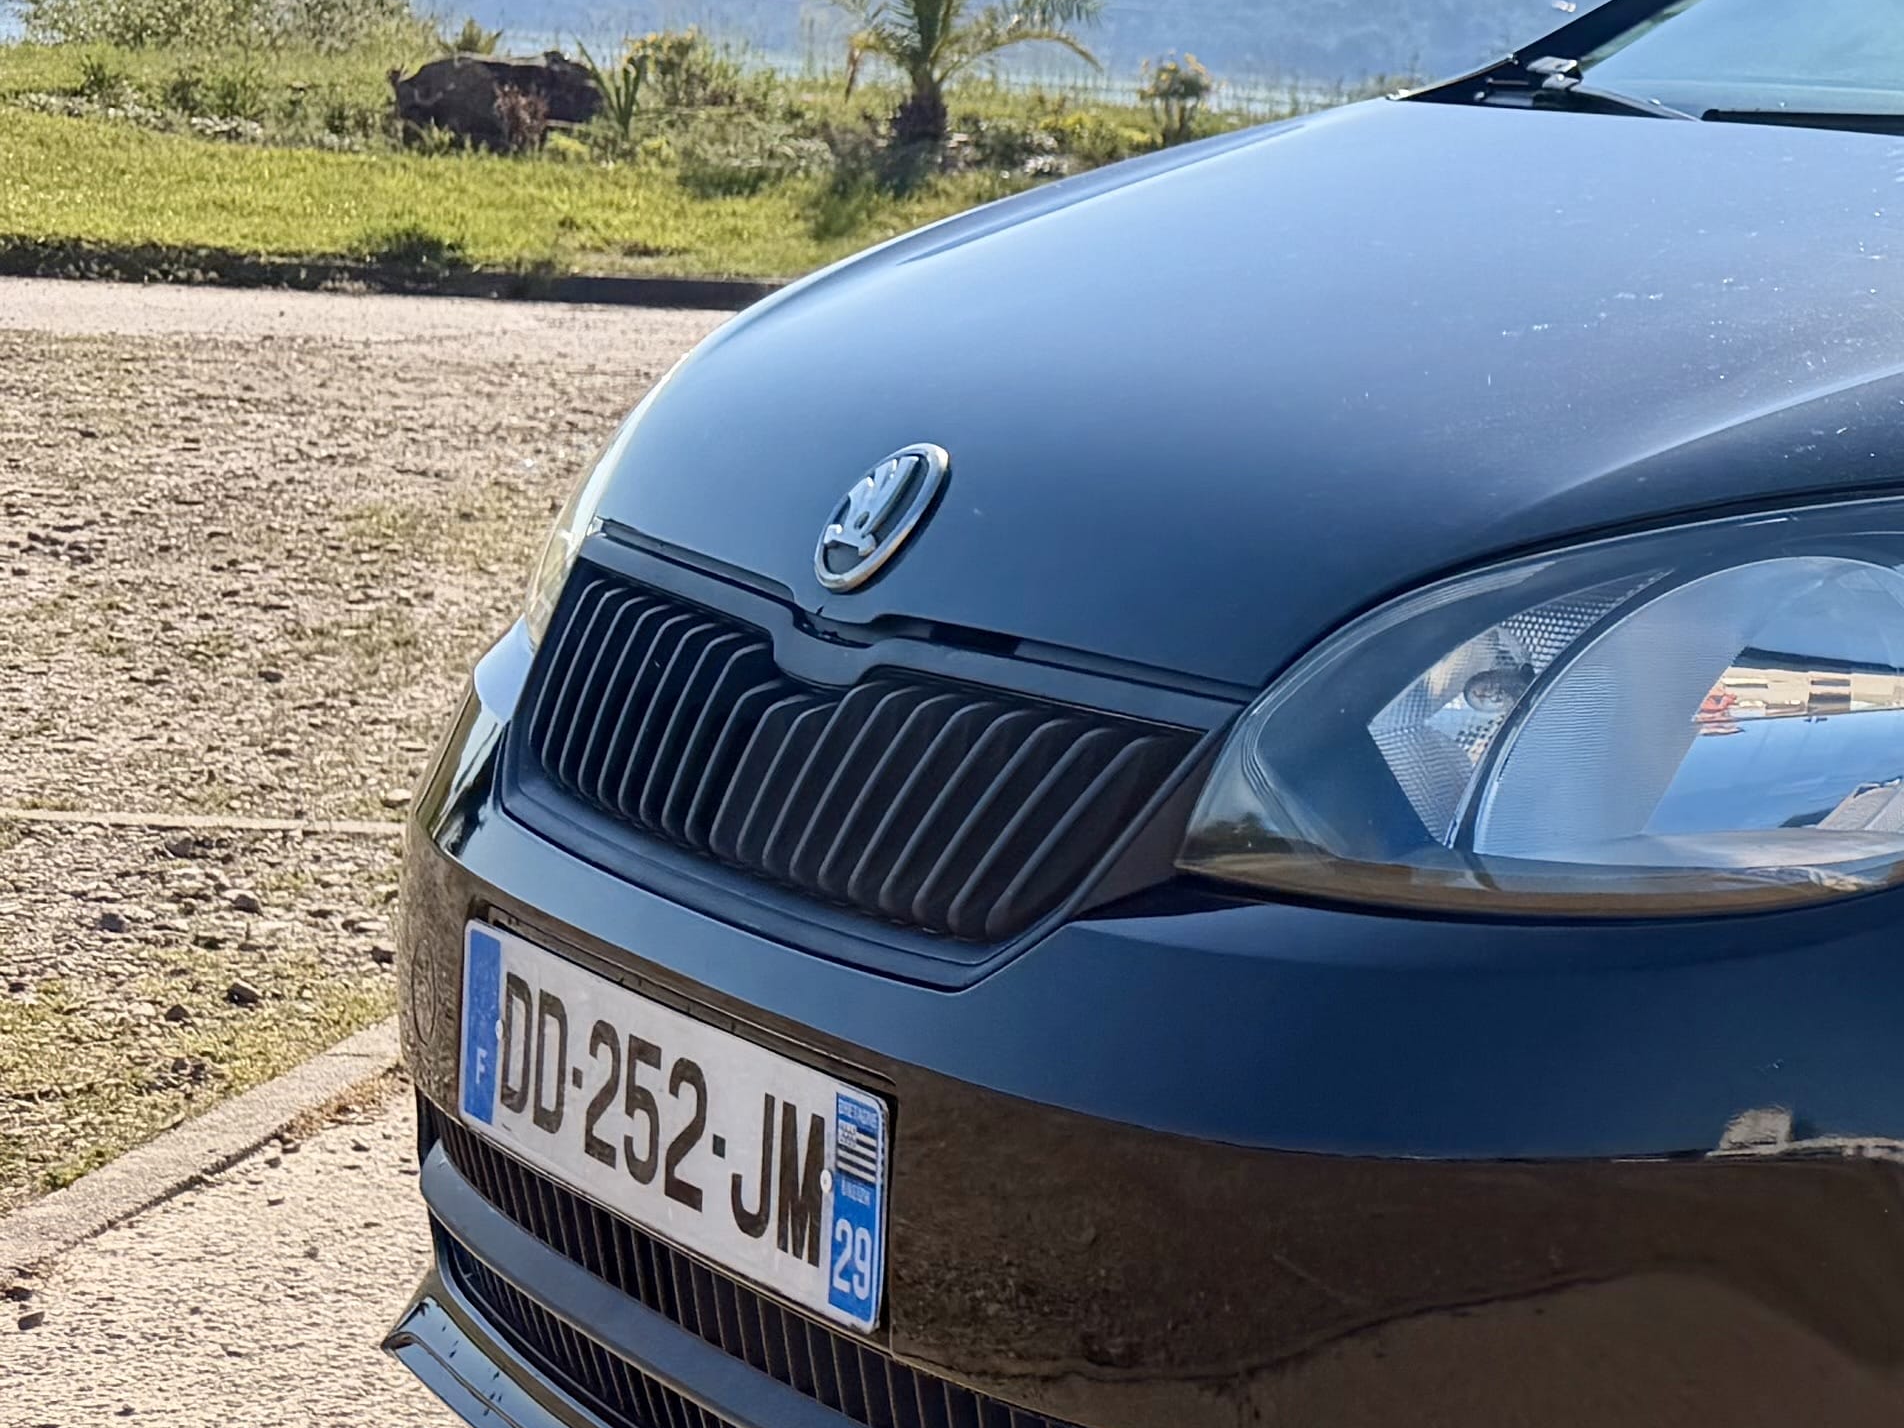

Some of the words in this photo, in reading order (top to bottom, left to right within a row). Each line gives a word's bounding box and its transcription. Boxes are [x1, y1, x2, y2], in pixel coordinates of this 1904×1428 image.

[475, 1048, 489, 1085] F
[500, 971, 826, 1269] DD-252-JM
[833, 1217, 873, 1301] 29
